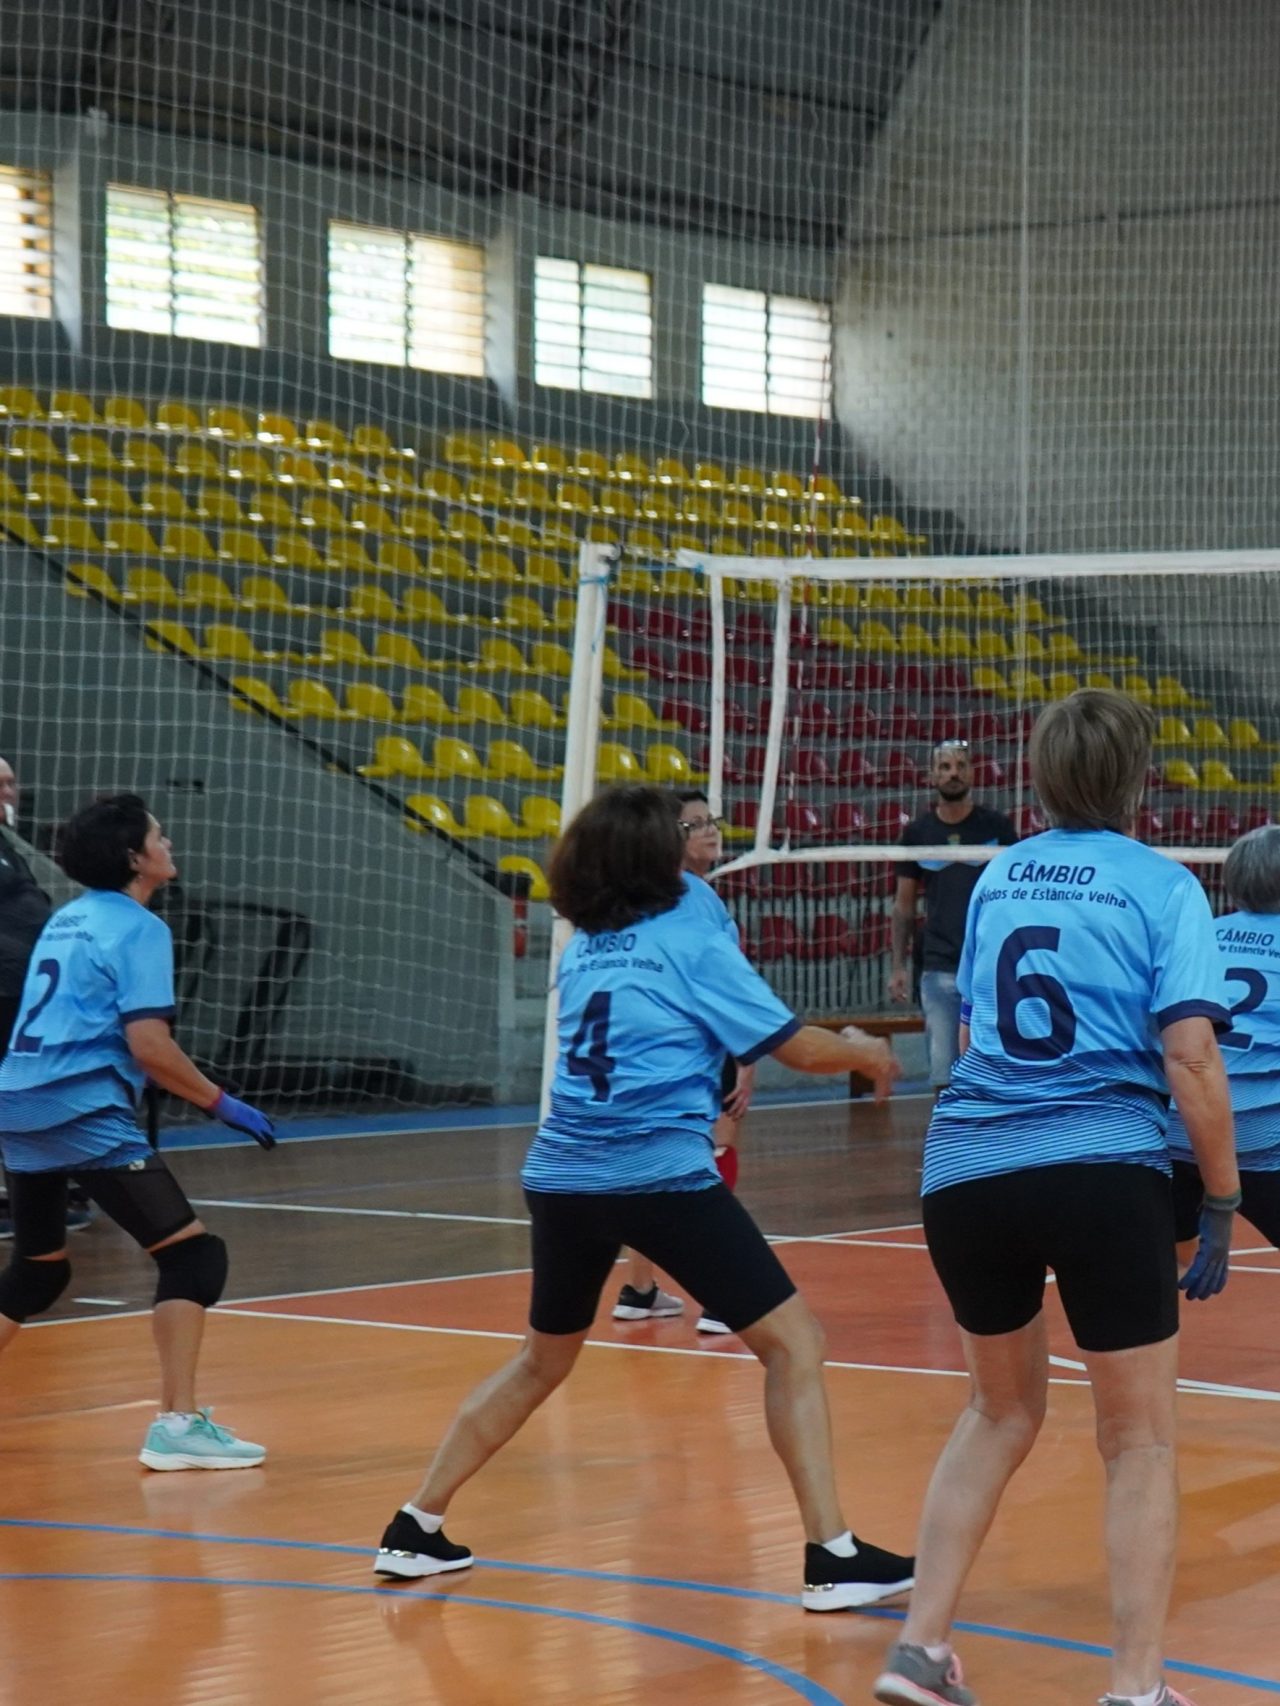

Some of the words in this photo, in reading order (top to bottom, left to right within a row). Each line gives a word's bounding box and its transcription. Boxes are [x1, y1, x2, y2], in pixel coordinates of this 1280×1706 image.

[1008, 860, 1095, 885] CÂMBIO
[1012, 887, 1027, 900] de
[1031, 888, 1084, 901] Estância
[1088, 891, 1127, 909] Velha
[15, 958, 60, 1054] 2
[997, 925, 1076, 1060] 6
[1217, 967, 1268, 1050] 2
[567, 991, 617, 1103] 4
